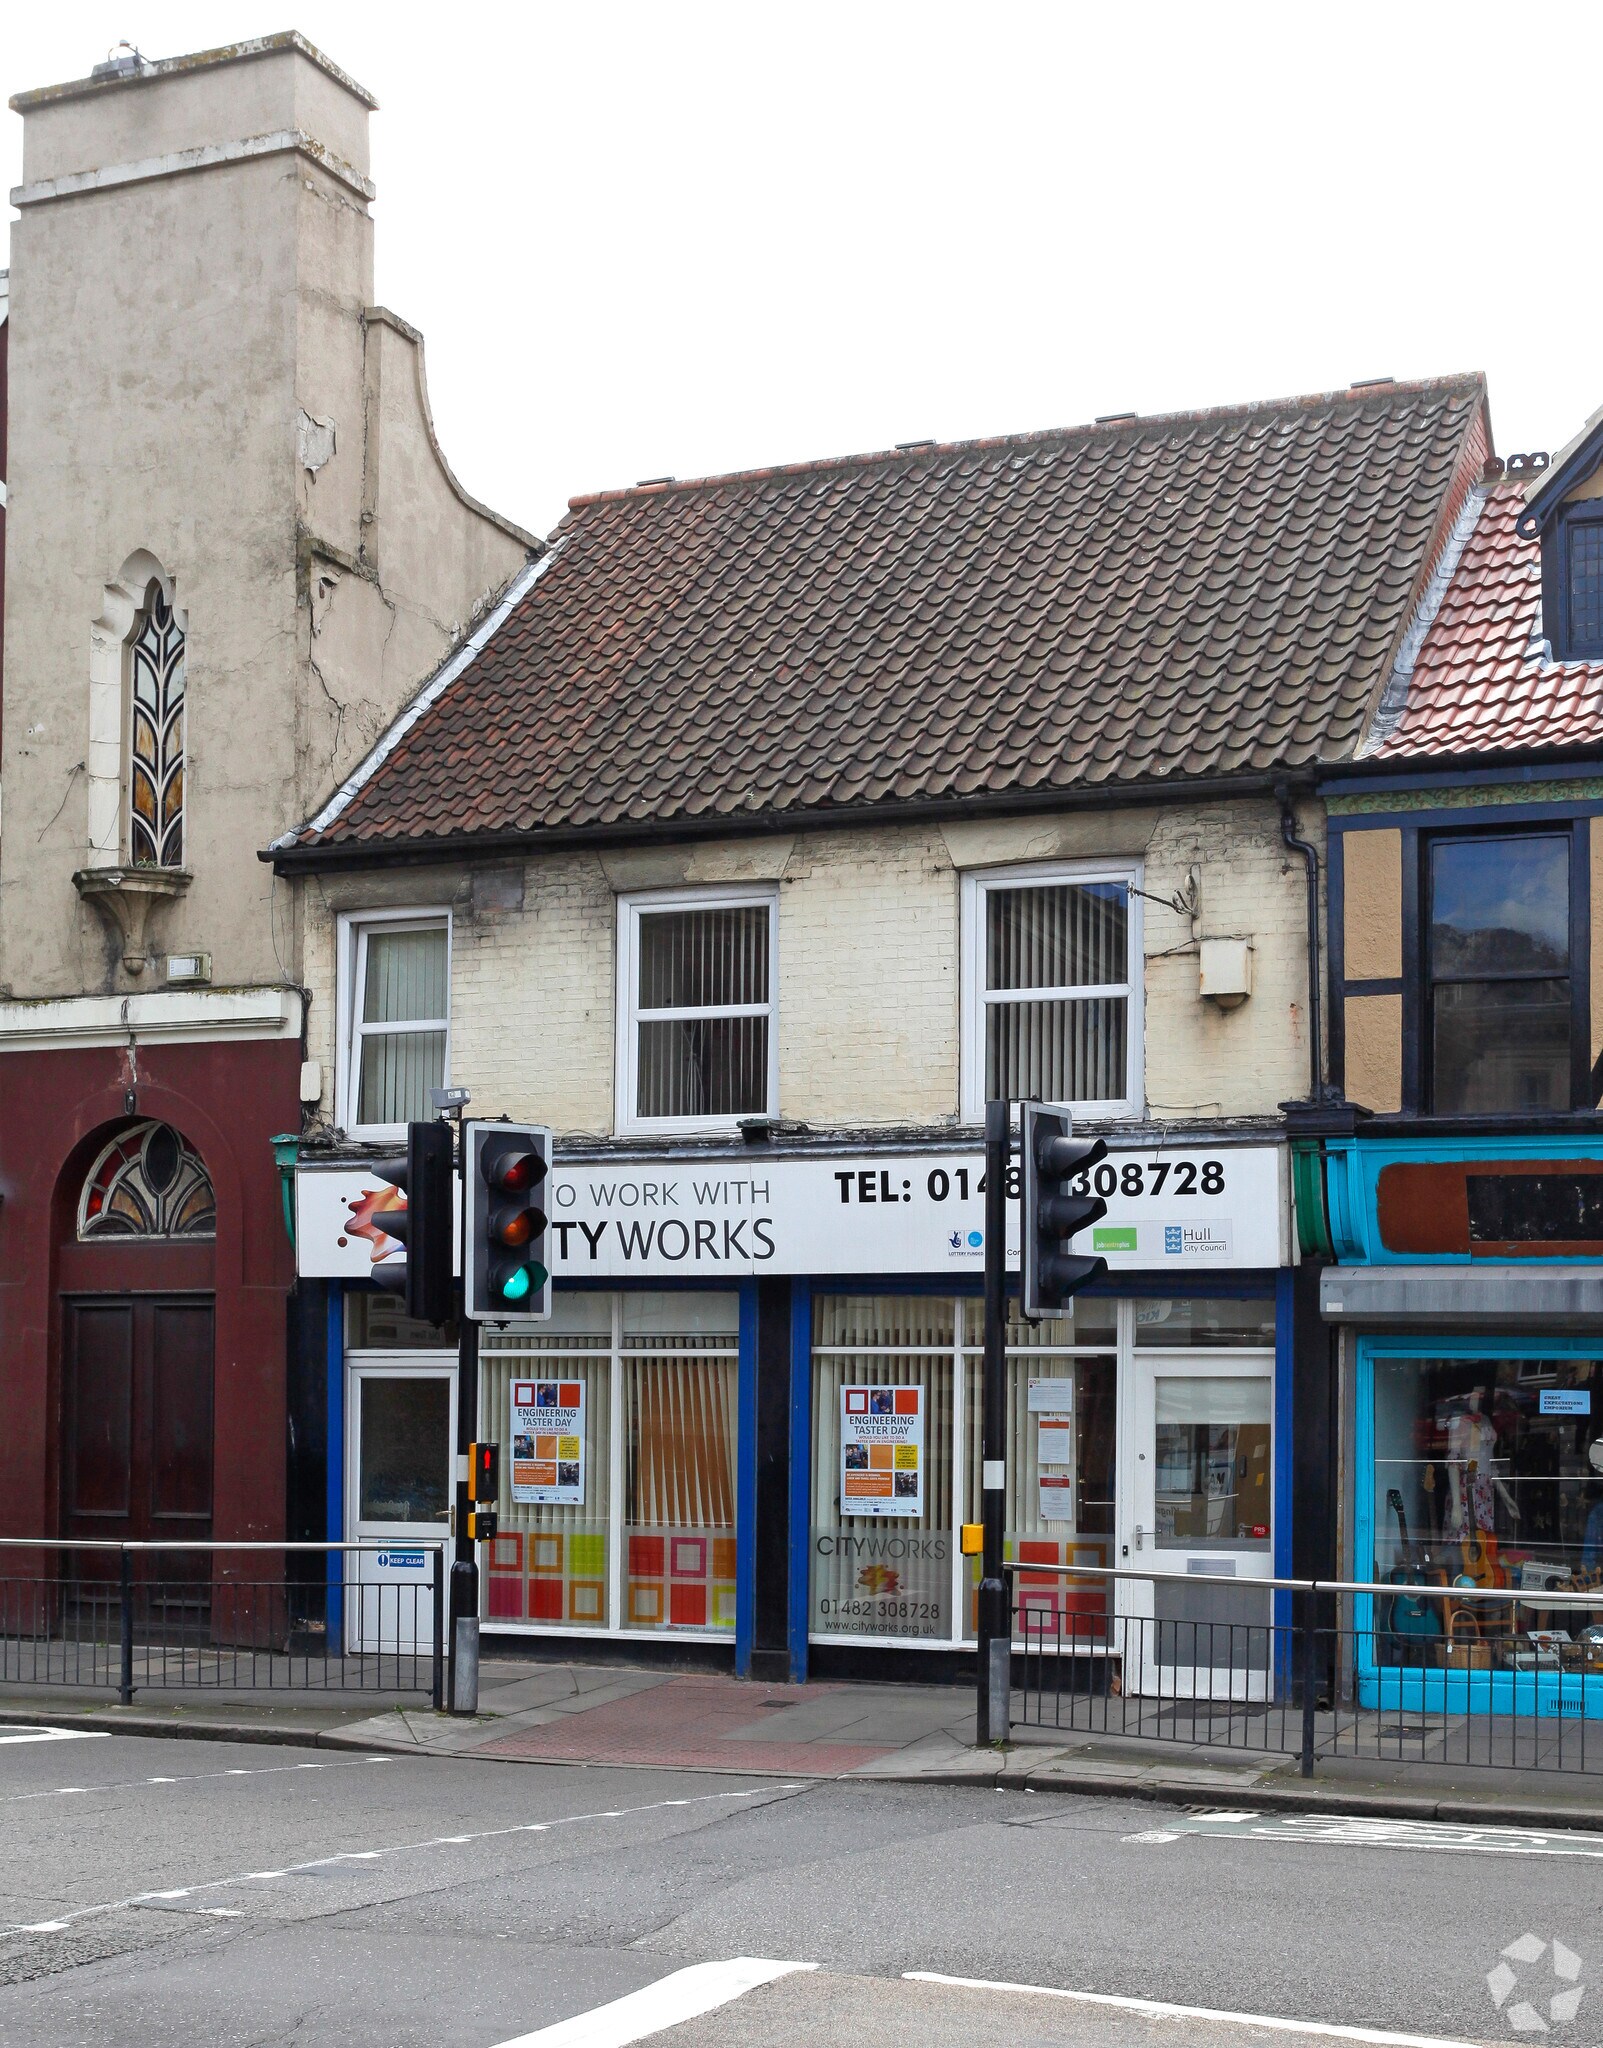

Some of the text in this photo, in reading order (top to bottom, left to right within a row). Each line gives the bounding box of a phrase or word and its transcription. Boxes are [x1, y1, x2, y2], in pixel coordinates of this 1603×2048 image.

[834, 1171, 912, 1203] TEL:
[1072, 1161, 1225, 1197] 308728
[552, 1180, 770, 1207] O WORK WITH
[1184, 1228, 1211, 1241] Hull
[1184, 1243, 1227, 1253] City Council
[517, 1408, 577, 1418] ENGINEERING
[522, 1418, 572, 1427] TASTER DAY
[849, 1416, 914, 1425] ENGINEERING
[854, 1425, 909, 1435] TASTER DAY
[816, 1536, 946, 1560] CITYWORKS
[405, 1557, 424, 1565] CLEAR
[820, 1598, 940, 1619] 01482 308728
[824, 1620, 936, 1636] www.cityworks.org.uk
